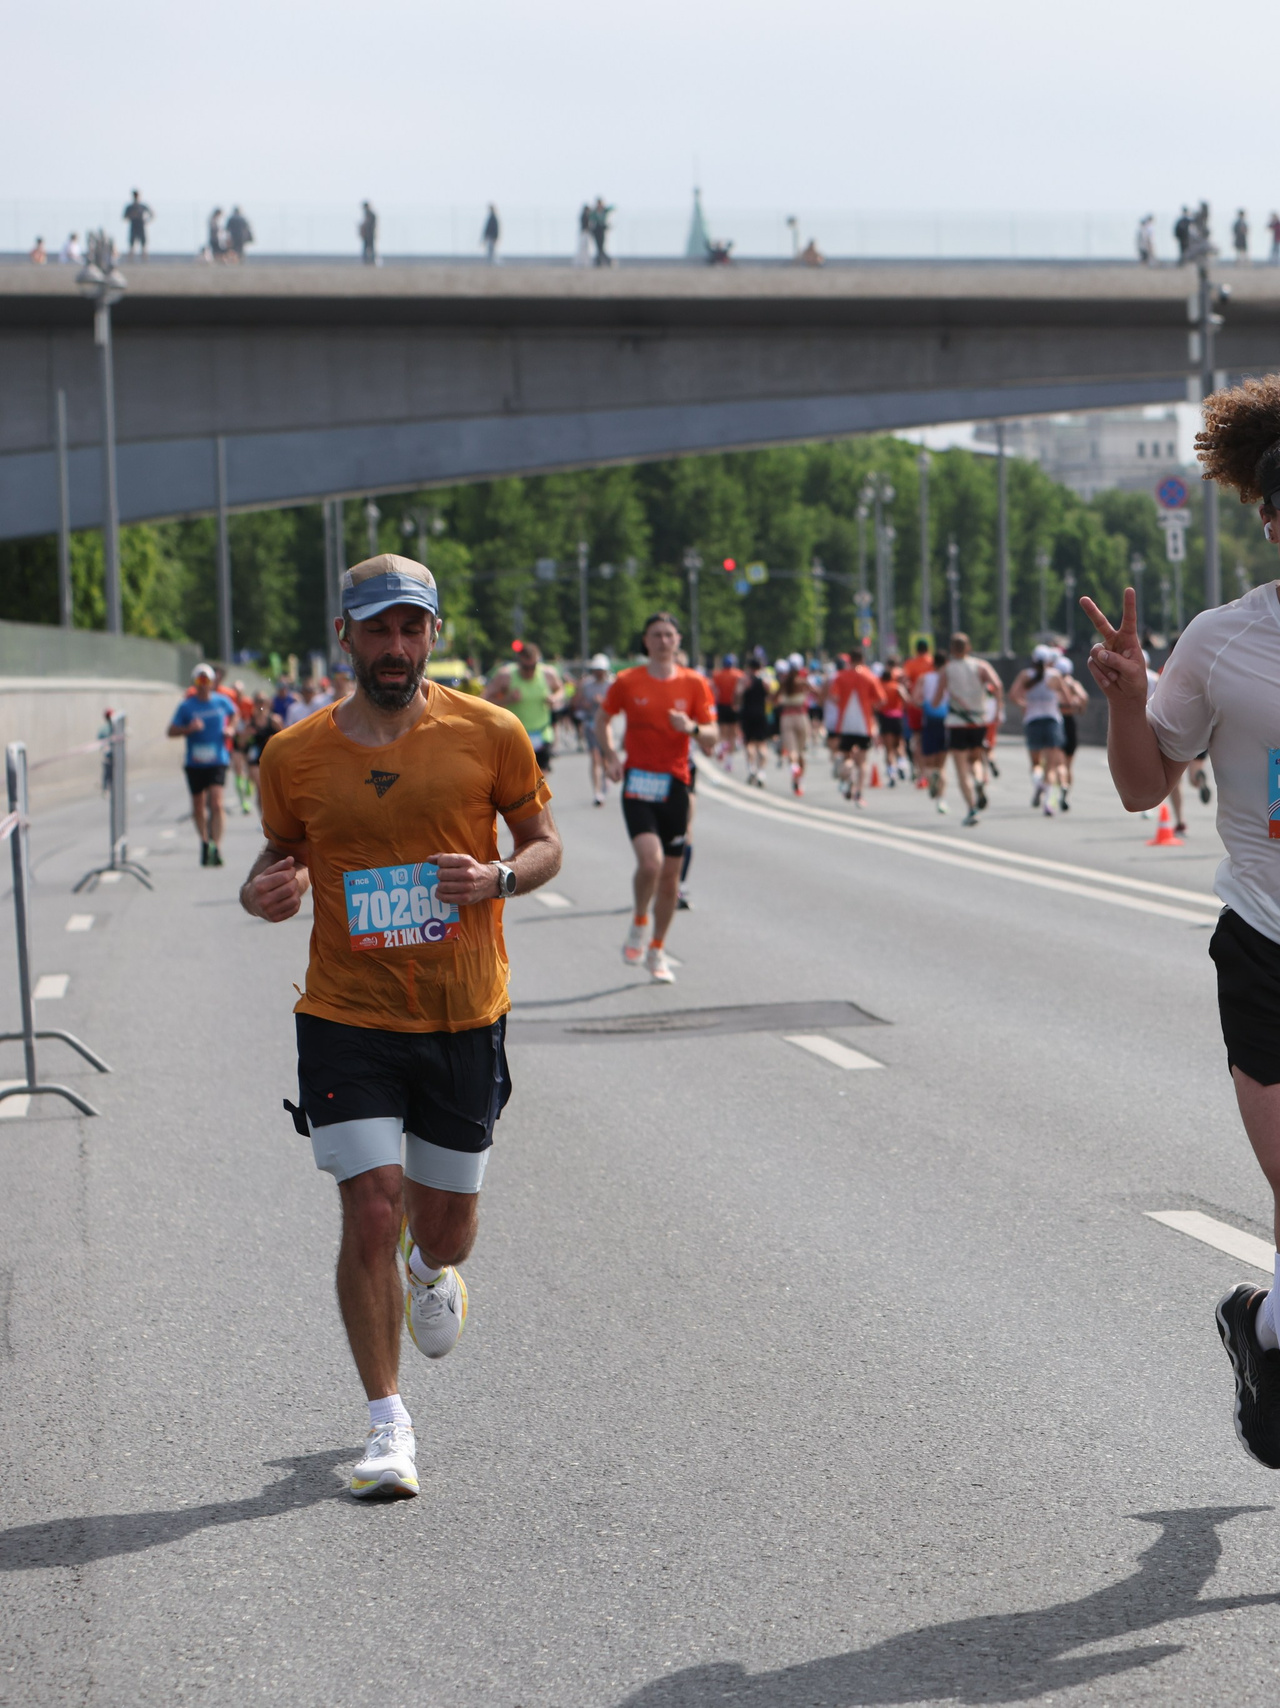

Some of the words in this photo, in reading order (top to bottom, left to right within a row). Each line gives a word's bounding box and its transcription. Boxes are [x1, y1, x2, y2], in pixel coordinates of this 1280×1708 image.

[355, 877, 370, 886] ПСБ
[389, 867, 408, 886] 10
[424, 921, 442, 942] C
